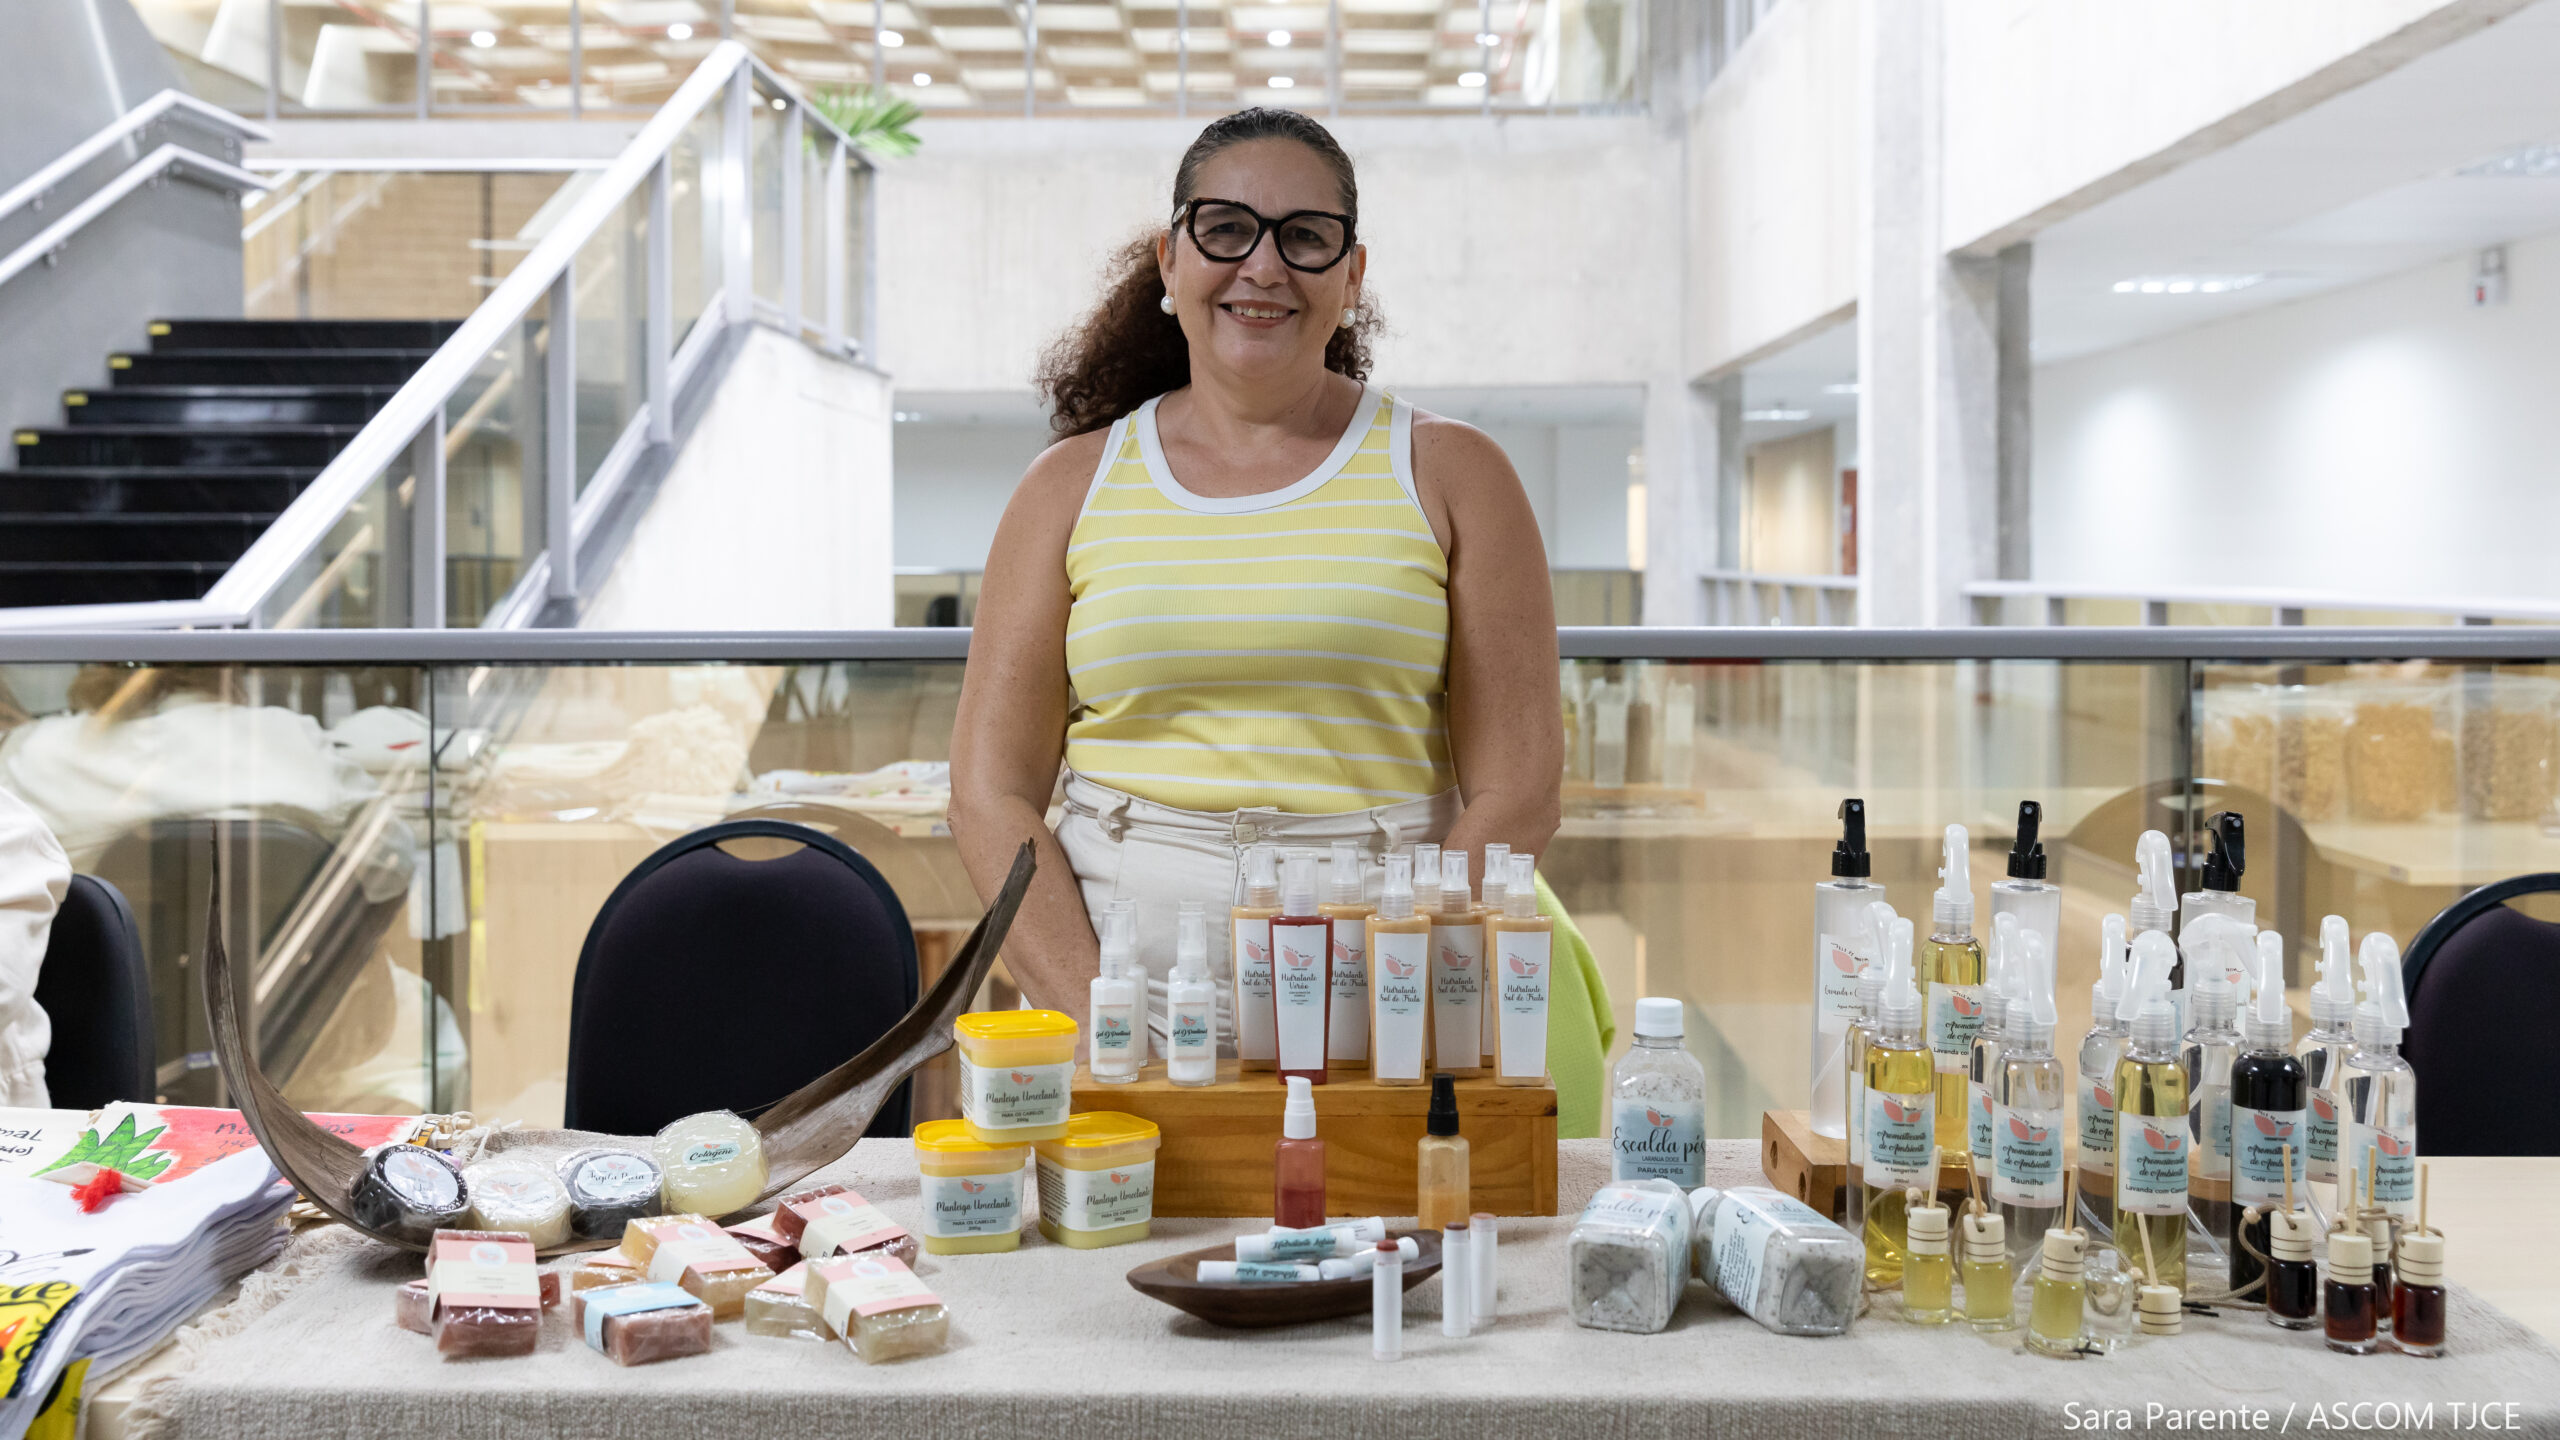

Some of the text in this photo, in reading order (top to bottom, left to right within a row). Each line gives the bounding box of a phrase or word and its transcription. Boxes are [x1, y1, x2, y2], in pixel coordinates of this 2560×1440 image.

[1933, 1047, 1958, 1055] Lavanda
[986, 1088, 1060, 1107] Manteiga Umectante
[1613, 1126, 1706, 1162] Escalda pés
[2010, 1176, 2044, 1186] Baunilha
[2126, 1184, 2153, 1194] Lavanda
[936, 1197, 1012, 1216] Manteiga Umectante
